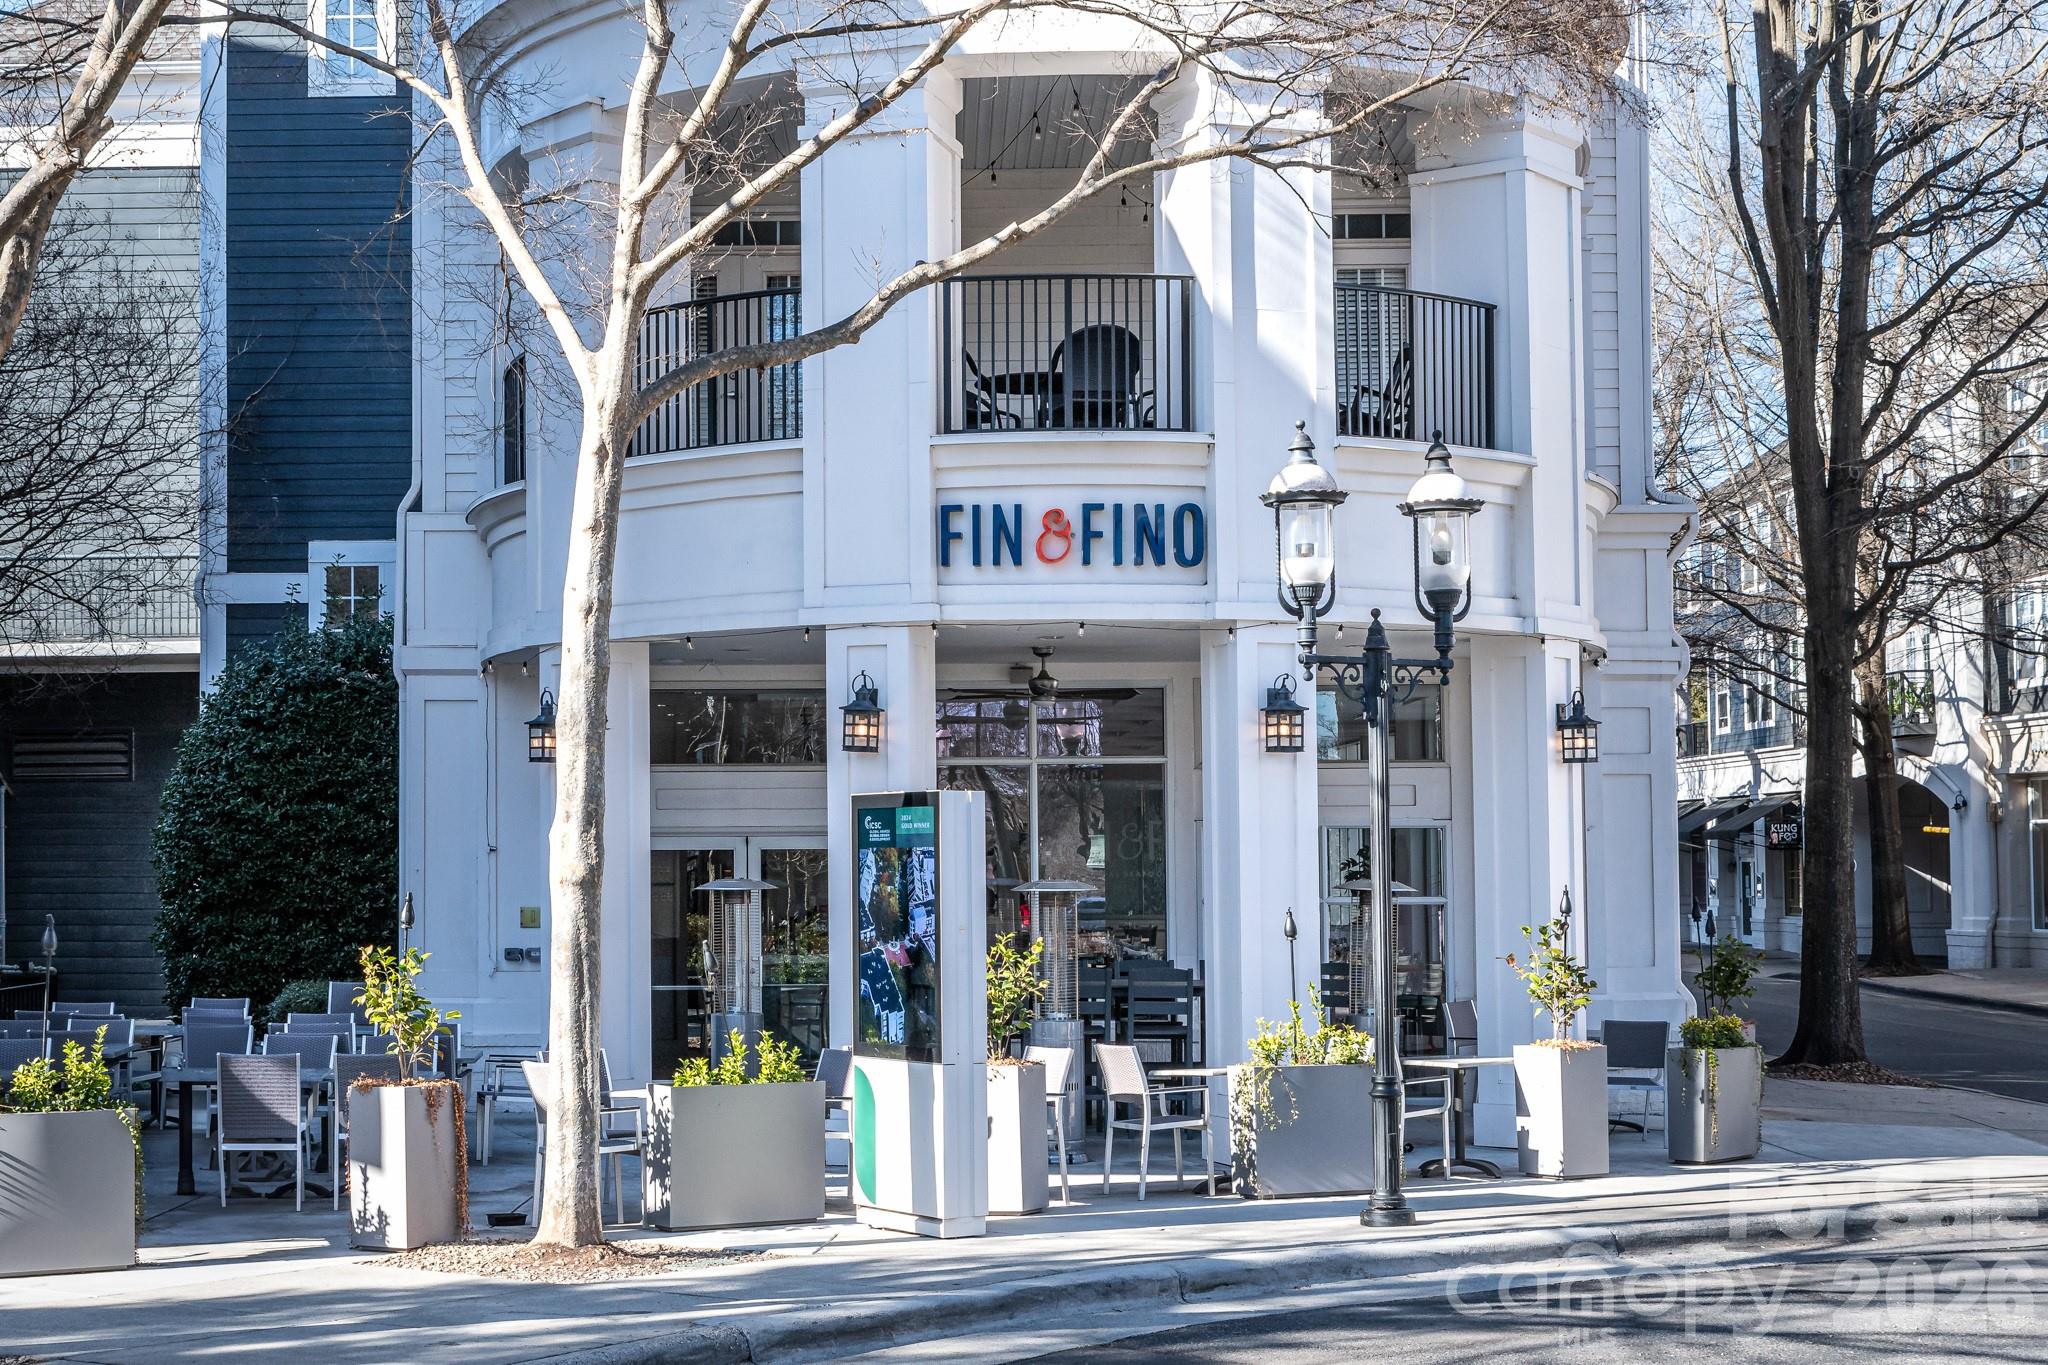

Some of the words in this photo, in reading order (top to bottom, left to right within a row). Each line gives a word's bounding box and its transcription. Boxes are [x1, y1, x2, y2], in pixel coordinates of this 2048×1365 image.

[940, 503, 1022, 567] FIN
[1035, 508, 1073, 565] &
[1081, 503, 1205, 568] FINO
[913, 821, 930, 829] WINNER
[1771, 823, 1798, 833] KUNG
